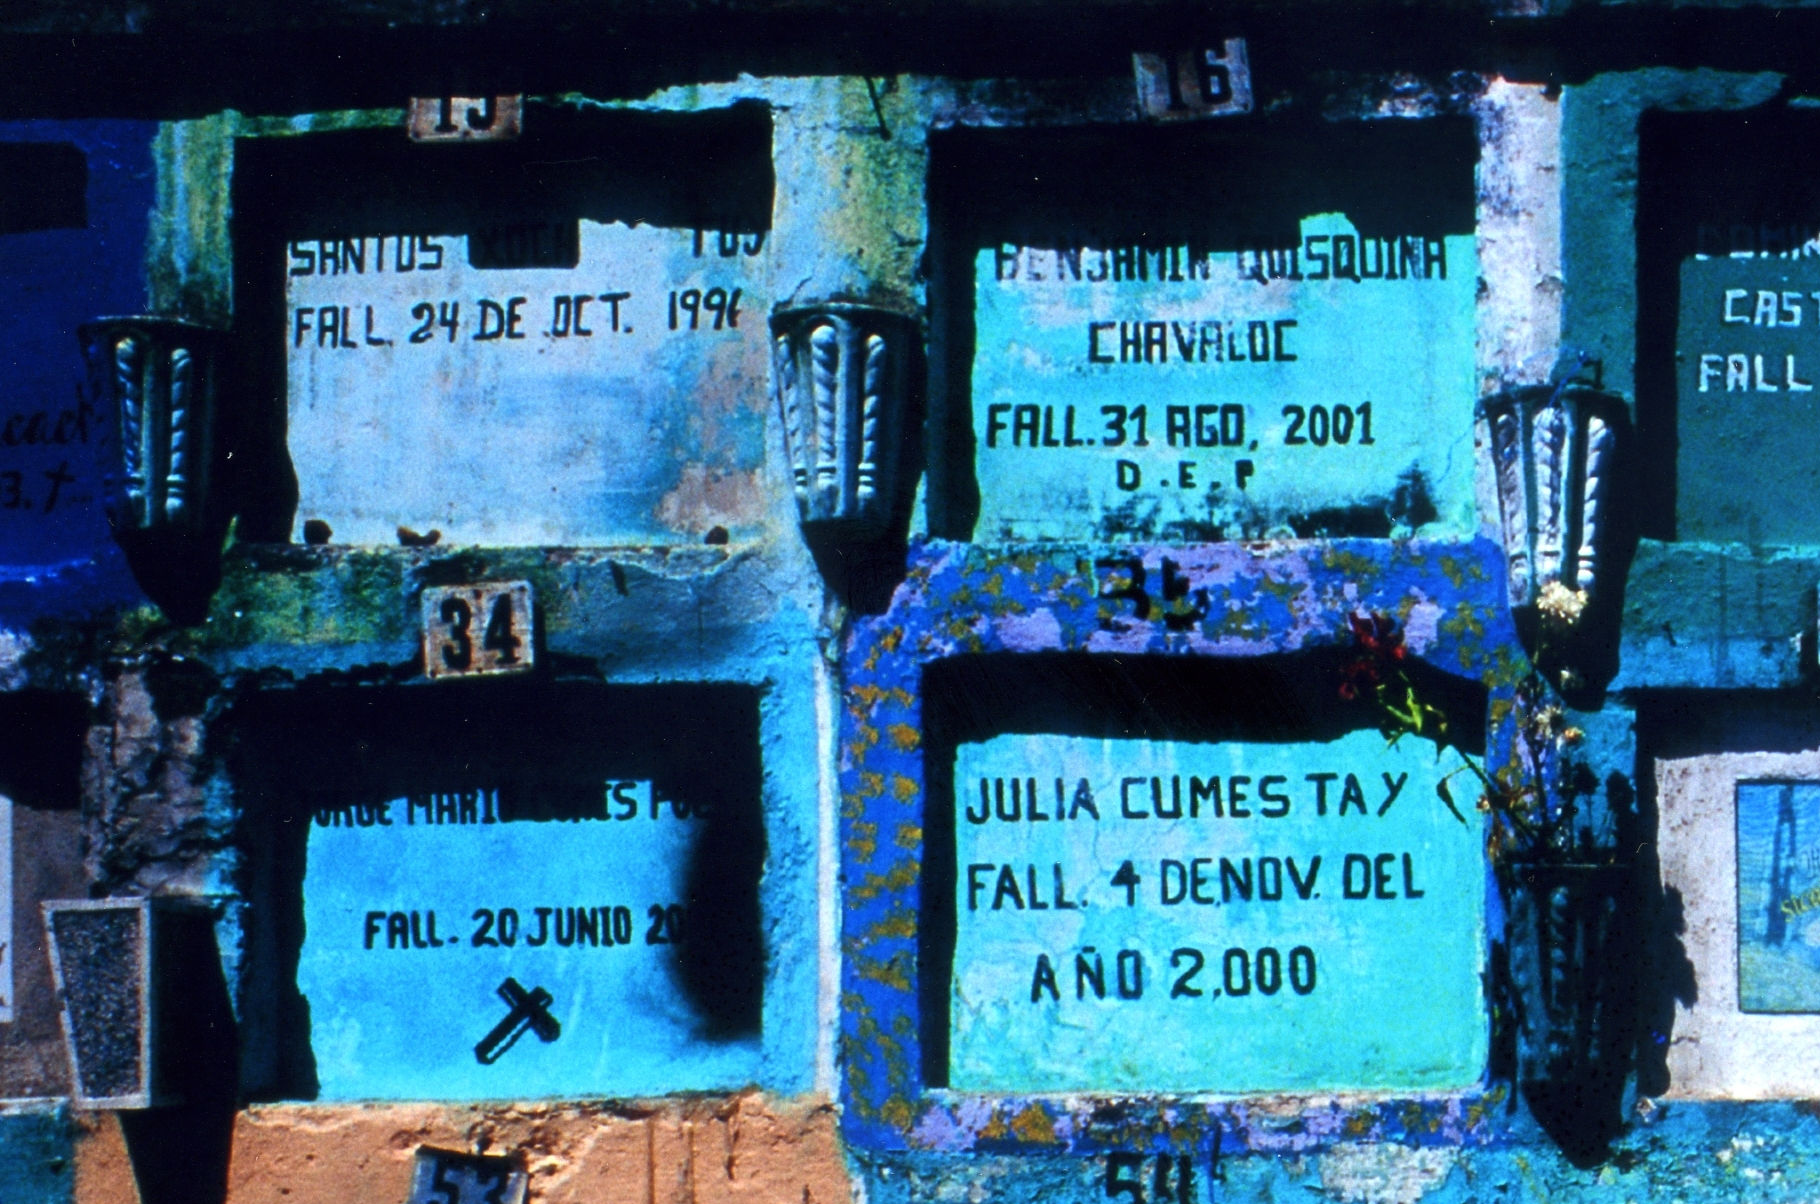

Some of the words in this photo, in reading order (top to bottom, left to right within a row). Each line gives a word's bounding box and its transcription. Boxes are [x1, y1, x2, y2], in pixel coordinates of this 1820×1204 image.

[409, 301, 460, 345] 24
[473, 296, 527, 340] DE
[1088, 320, 1299, 364] CHAVALOC
[986, 403, 1095, 448] FALL.
[1101, 403, 1149, 446] 31
[1282, 401, 1375, 446] 2001
[441, 598, 520, 669] 34
[966, 776, 1101, 825] JULIA
[1120, 774, 1290, 819] CUMES
[967, 862, 1089, 911] FALL.
[1110, 859, 1141, 906] 4
[1342, 852, 1426, 900] DEL
[364, 911, 459, 949] FALL.
[471, 907, 519, 949] 20
[526, 905, 632, 947] JUNIO
[1031, 946, 1143, 1003] AÑO
